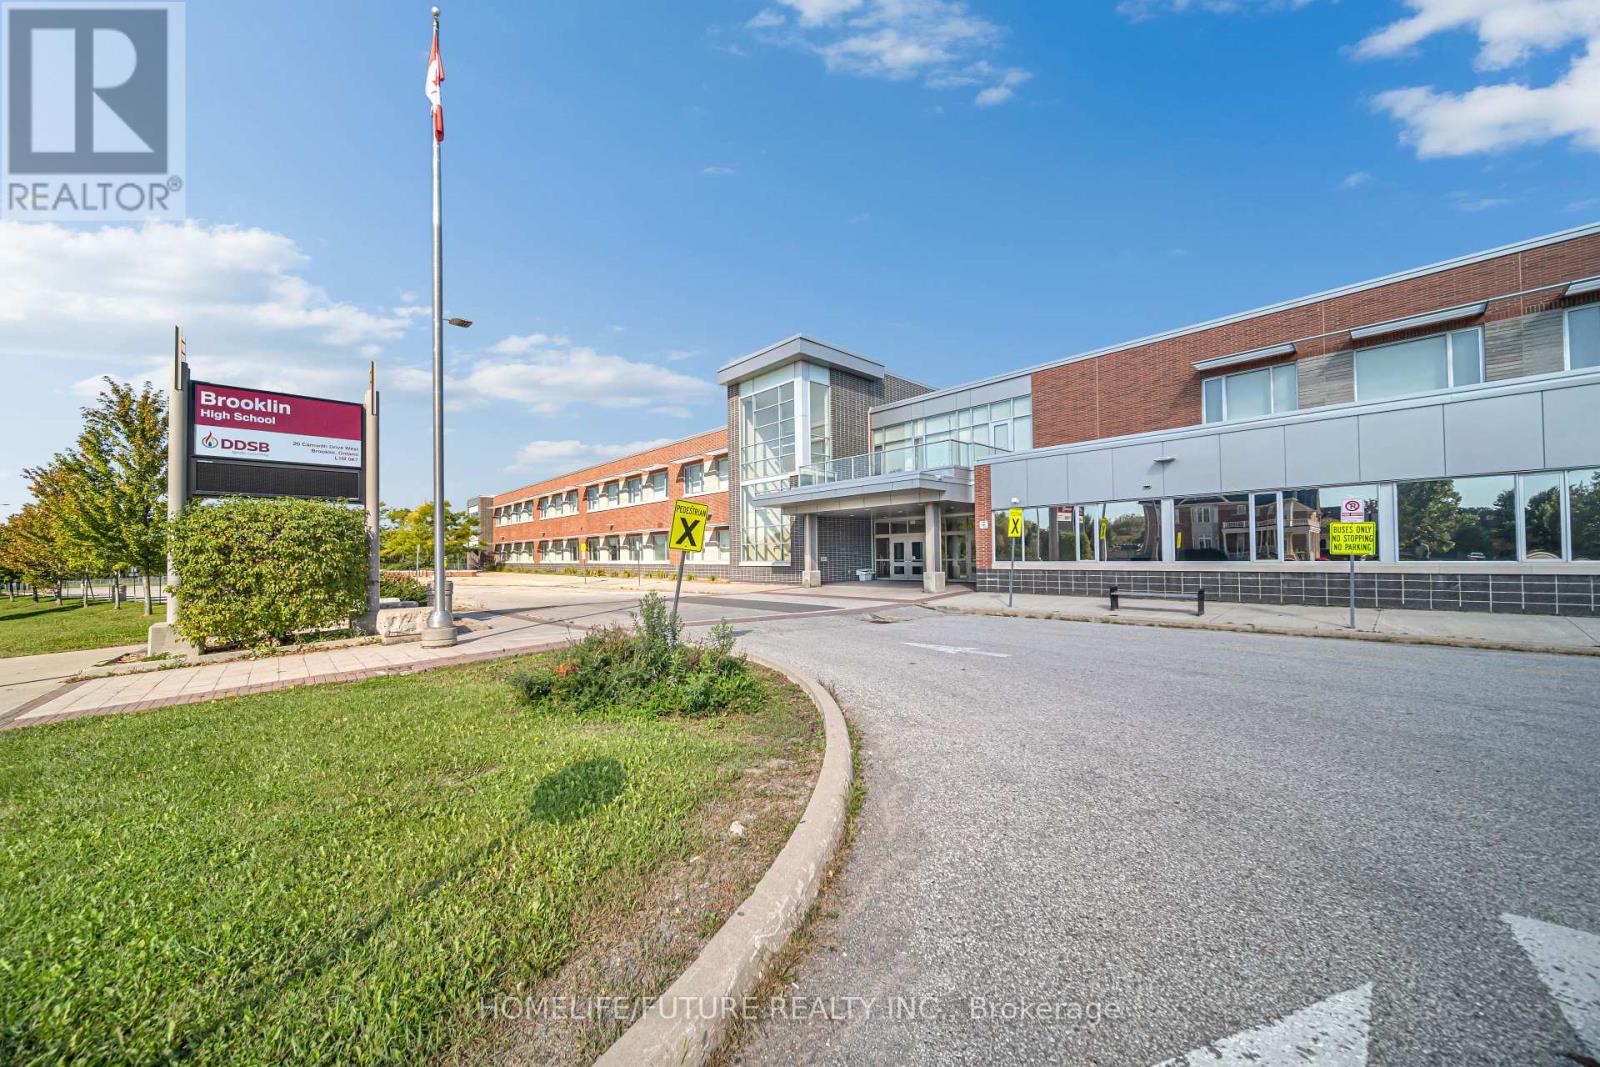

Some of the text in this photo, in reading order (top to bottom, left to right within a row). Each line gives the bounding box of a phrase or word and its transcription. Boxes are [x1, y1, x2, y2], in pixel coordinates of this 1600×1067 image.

[200, 390, 291, 415] Brooklin
[200, 408, 276, 424] High School
[221, 438, 270, 453] DDSB
[676, 504, 707, 518] PEDESTRIAN
[675, 517, 701, 547] X
[1011, 518, 1020, 534] X
[1333, 543, 1372, 551] NO PARKING
